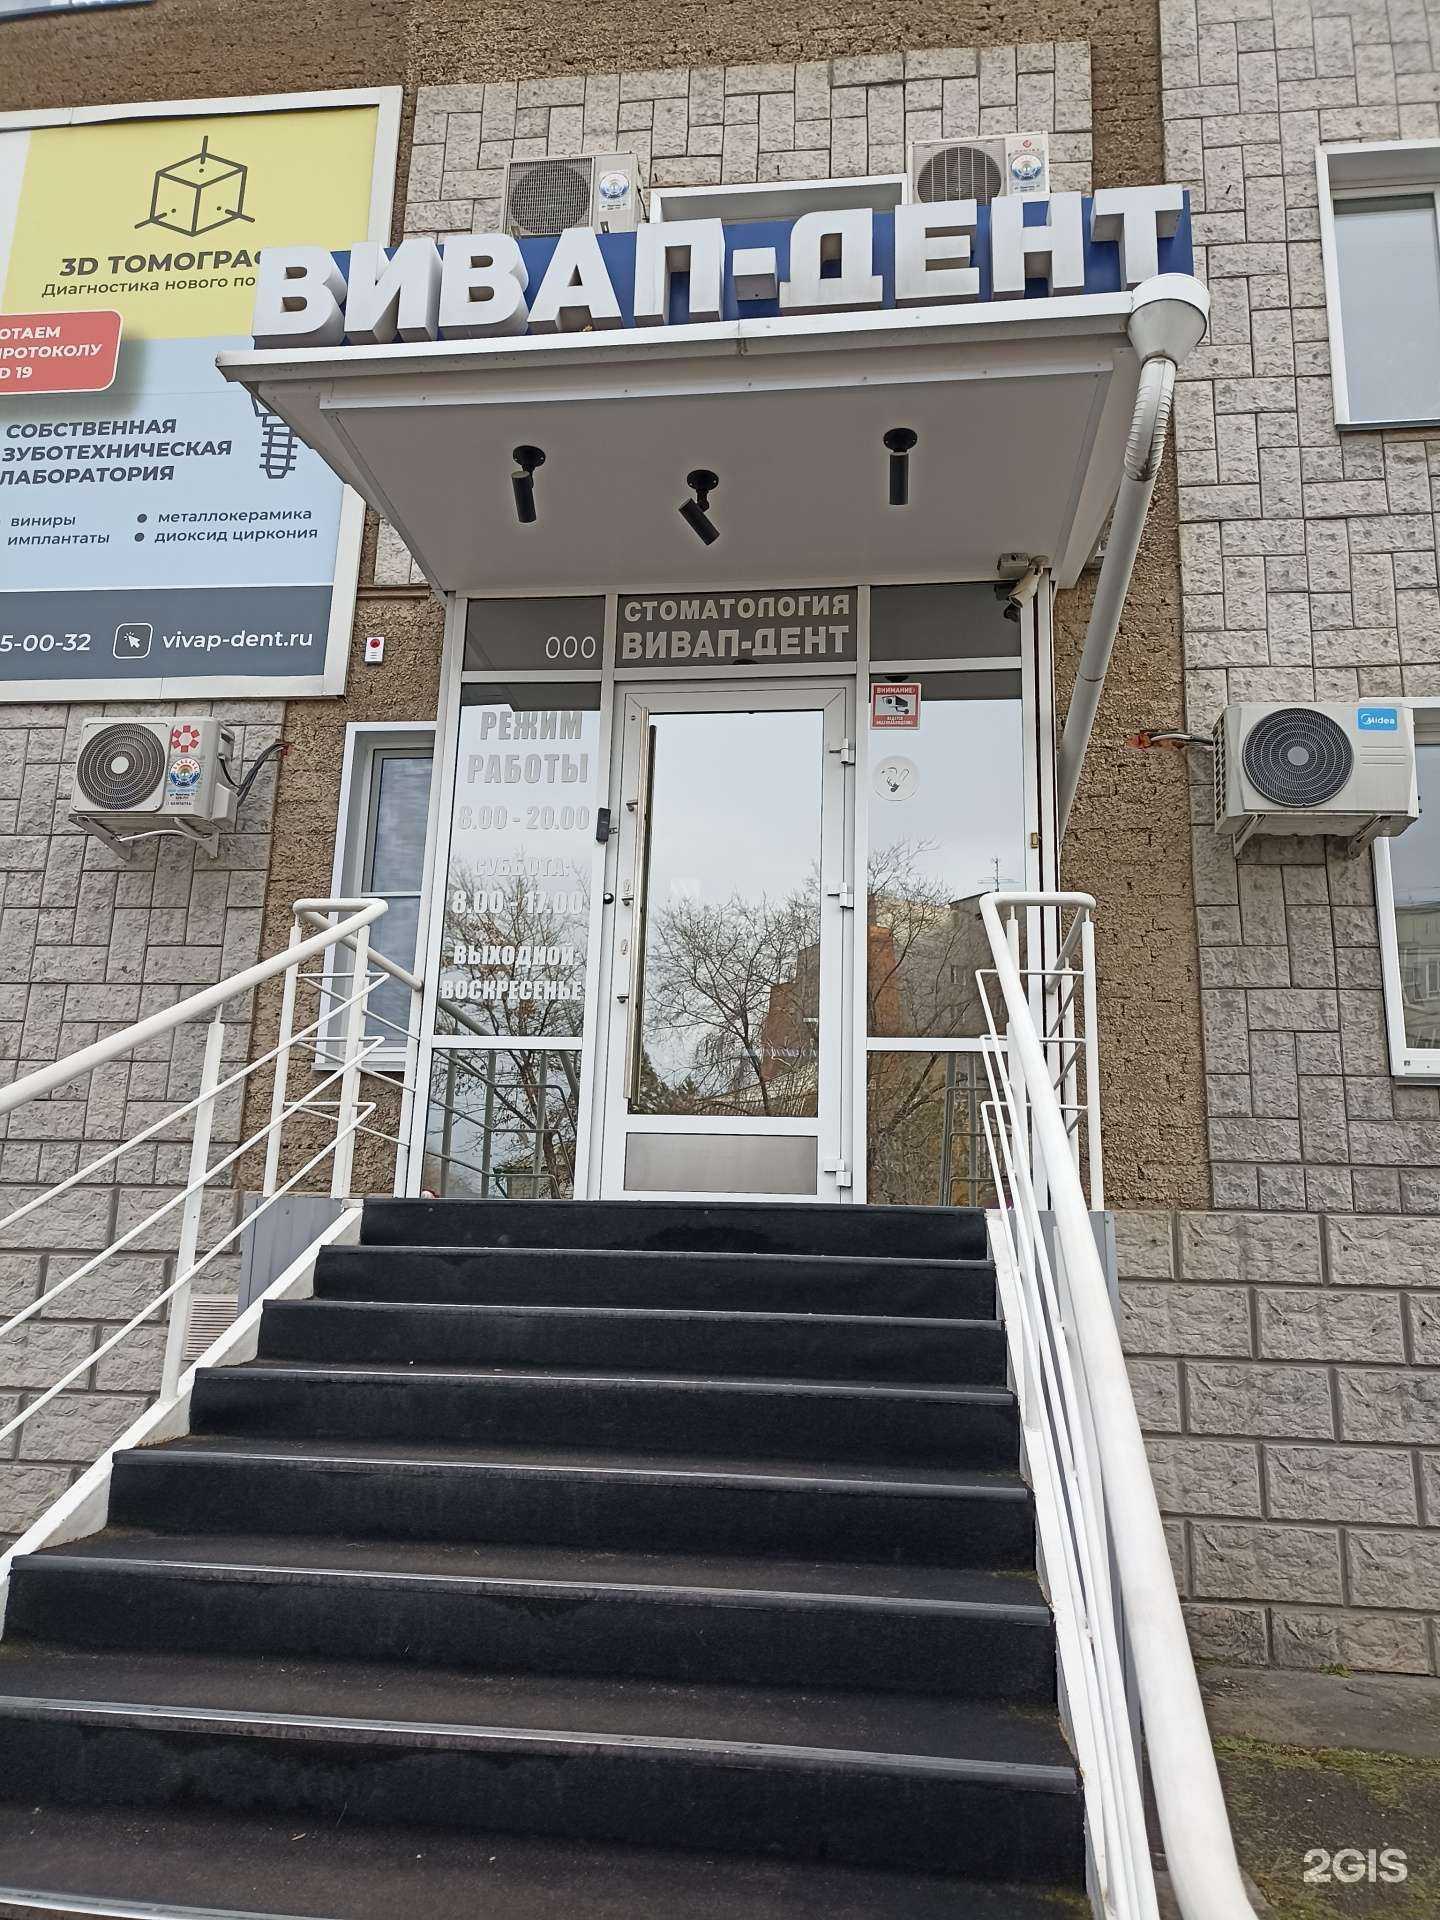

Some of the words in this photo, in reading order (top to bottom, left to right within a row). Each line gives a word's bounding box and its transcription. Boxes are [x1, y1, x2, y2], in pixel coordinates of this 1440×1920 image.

[59, 257, 99, 276] 3D
[252, 184, 1185, 349] ВИВАП-ДЕНТ
[41, 281, 160, 298] Диагностика
[165, 277, 228, 290] нового
[16, 366, 33, 379] 19
[6, 418, 177, 439] СОБСТВЕННАЯ
[1, 440, 233, 463] ЗУБОТЕХНИЧЕСКАЯ
[0, 465, 175, 486] ЛАБОРАТОРИЯ
[10, 514, 76, 529] виниры
[158, 509, 313, 524] металлокерамика
[7, 531, 110, 546] имплантаты
[154, 530, 228, 544] диоксид
[232, 528, 319, 543] циркония
[624, 594, 850, 622] СТОМАТОЛОГИЯ
[162, 629, 313, 652] vivap-dent.ru
[621, 624, 850, 660] ВИВАП-ДЕНТ
[480, 711, 583, 741] РЕЖИМ
[1366, 717, 1395, 725] Midea
[467, 753, 590, 785] РАБОТЫ
[526, 805, 591, 831] 20.00
[452, 889, 504, 915] 8.00
[440, 980, 585, 1001] ВОСКРЕСЕНЬЕ
